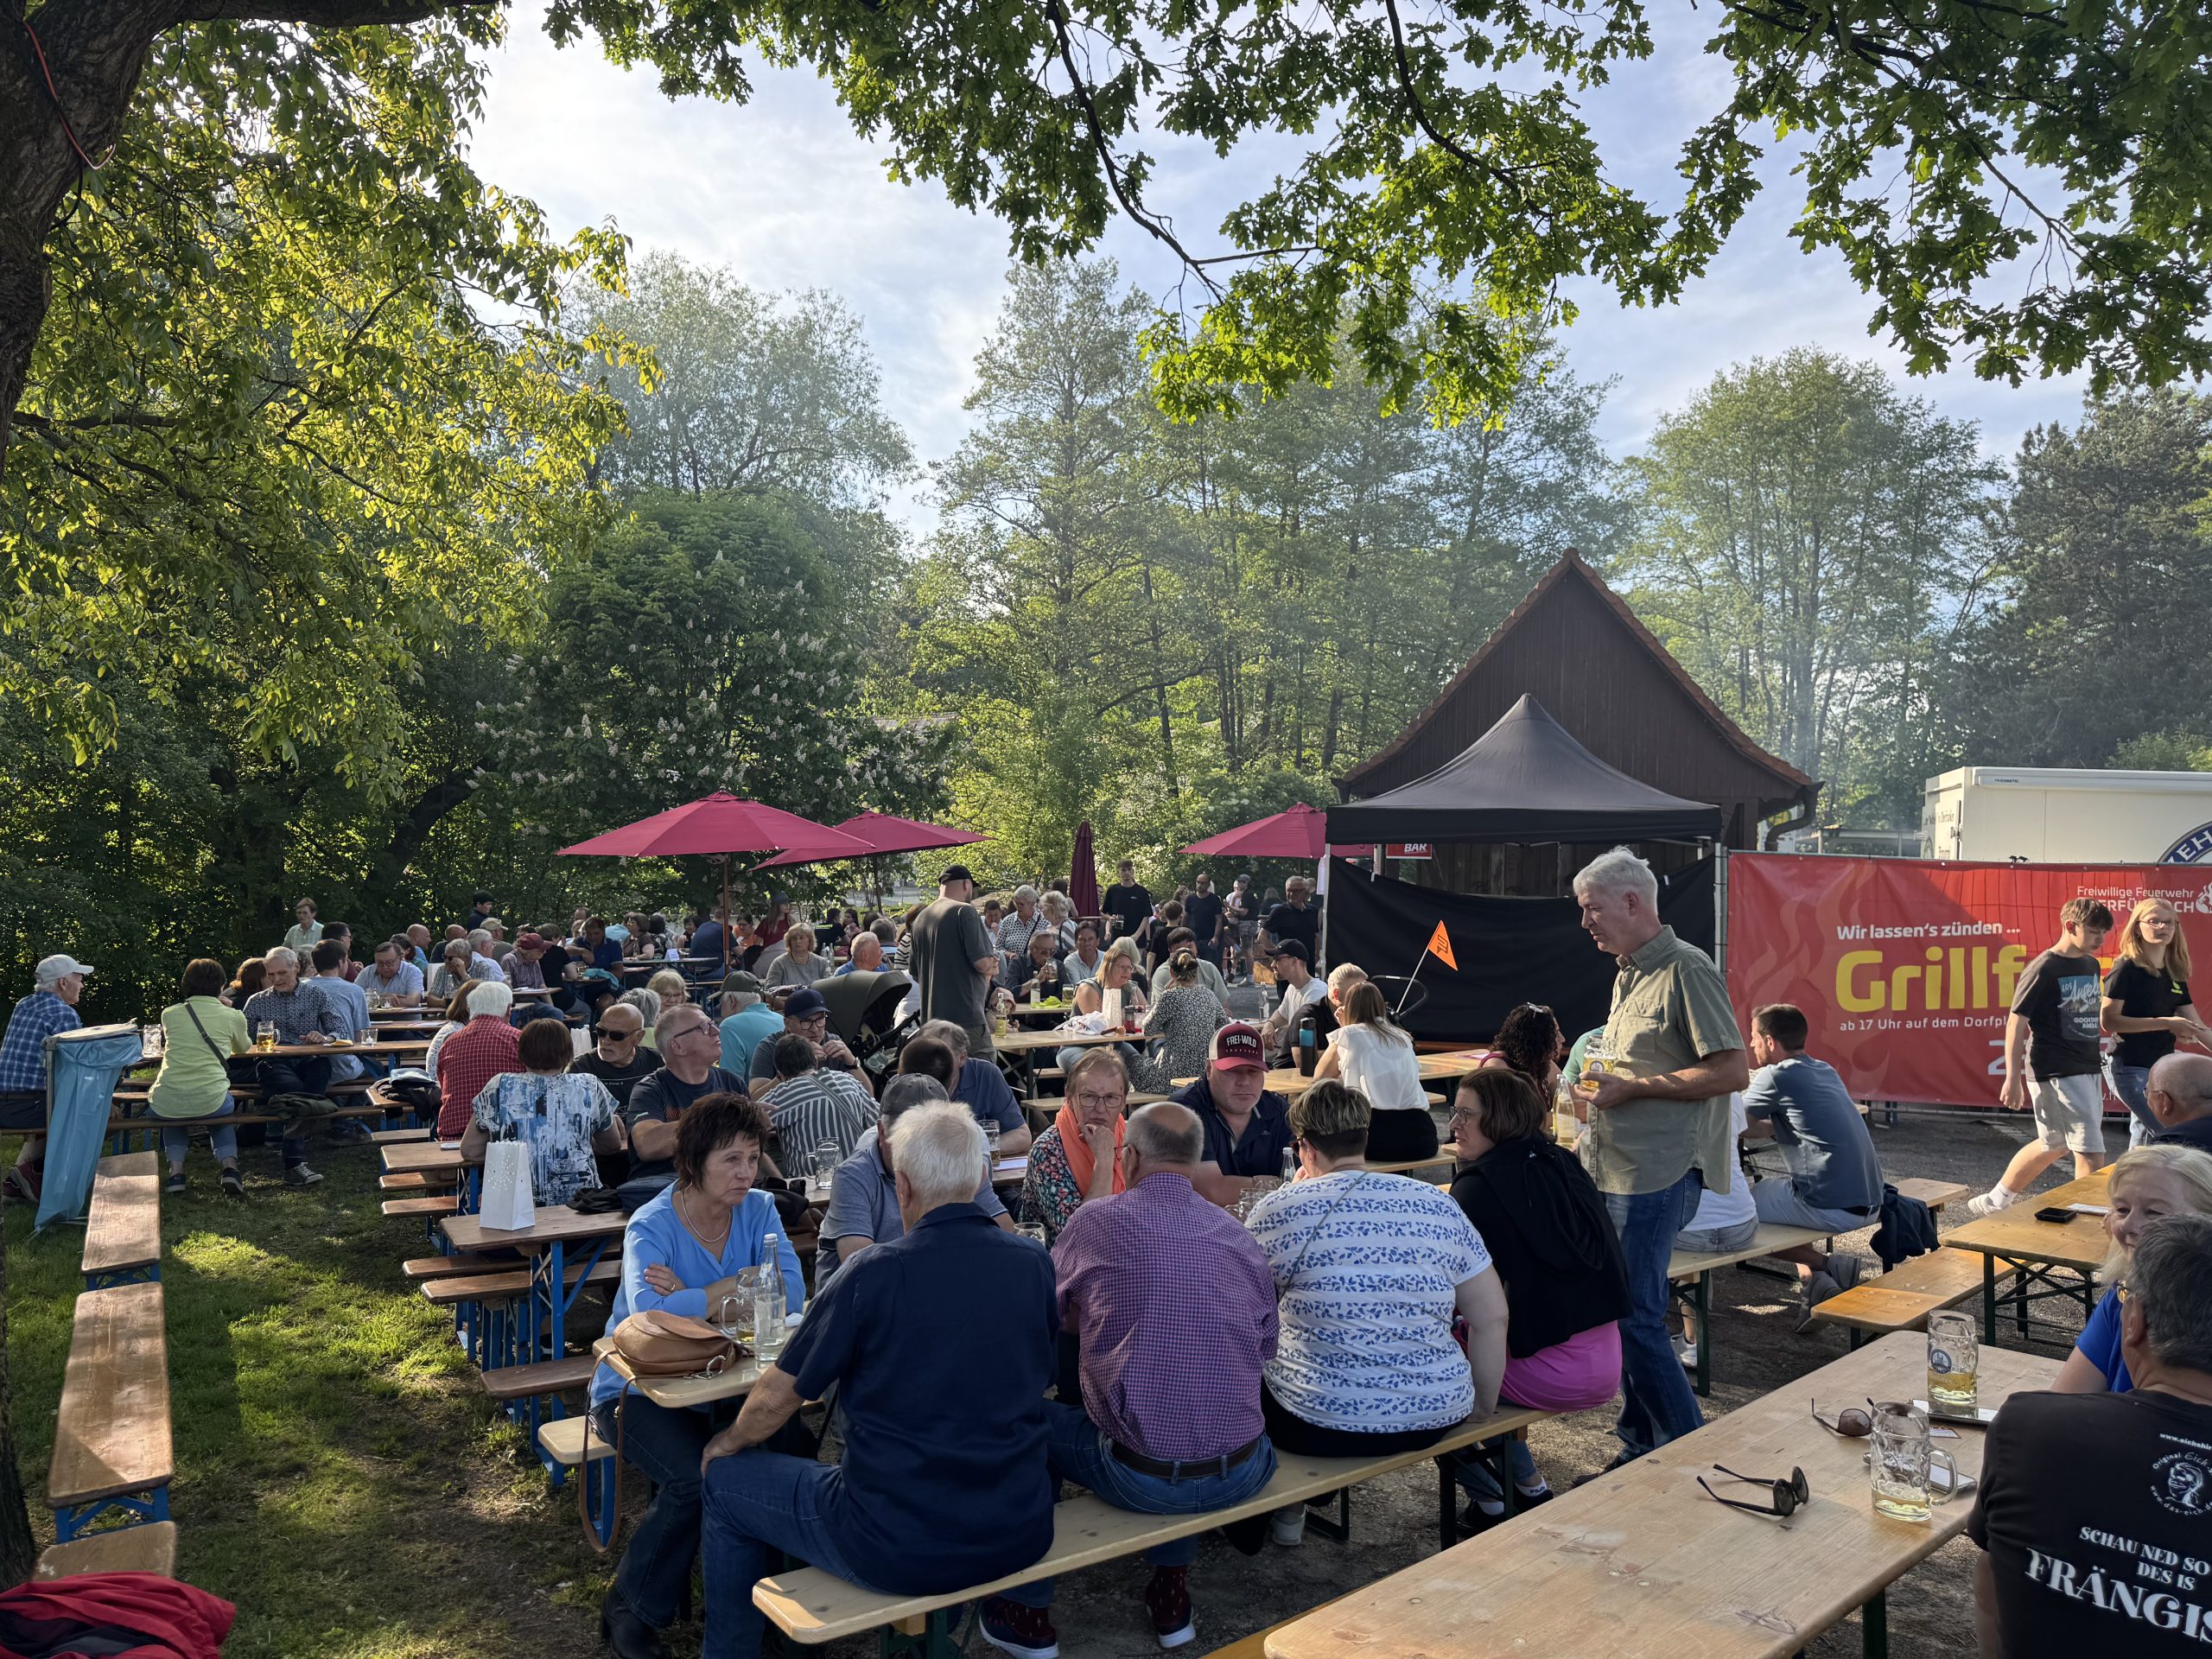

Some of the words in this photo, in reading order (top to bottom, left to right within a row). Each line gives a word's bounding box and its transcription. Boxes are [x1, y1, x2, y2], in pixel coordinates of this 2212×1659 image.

[1403, 842, 1427, 853] BAR
[2077, 886, 2133, 898] Freiwillige
[2136, 887, 2195, 898] Feuerwehr
[1837, 925, 1866, 940] Wir
[1942, 919, 2003, 938] zünden
[1835, 944, 2027, 1013] Grillf
[1840, 1020, 1855, 1031] ab
[1859, 1020, 1873, 1030] 17
[1878, 1019, 1902, 1029] Uhr
[1905, 1018, 1928, 1028] auf
[1932, 1017, 1959, 1028] dem
[1964, 1015, 2007, 1028] Dorfpl
[2152, 1452, 2181, 1469] Original
[2079, 1526, 2139, 1554] SCHAU
[2140, 1542, 2178, 1567] NED
[2183, 1556, 2211, 1575] SO
[2136, 1560, 2173, 1585] DES
[2177, 1573, 2196, 1591] IS
